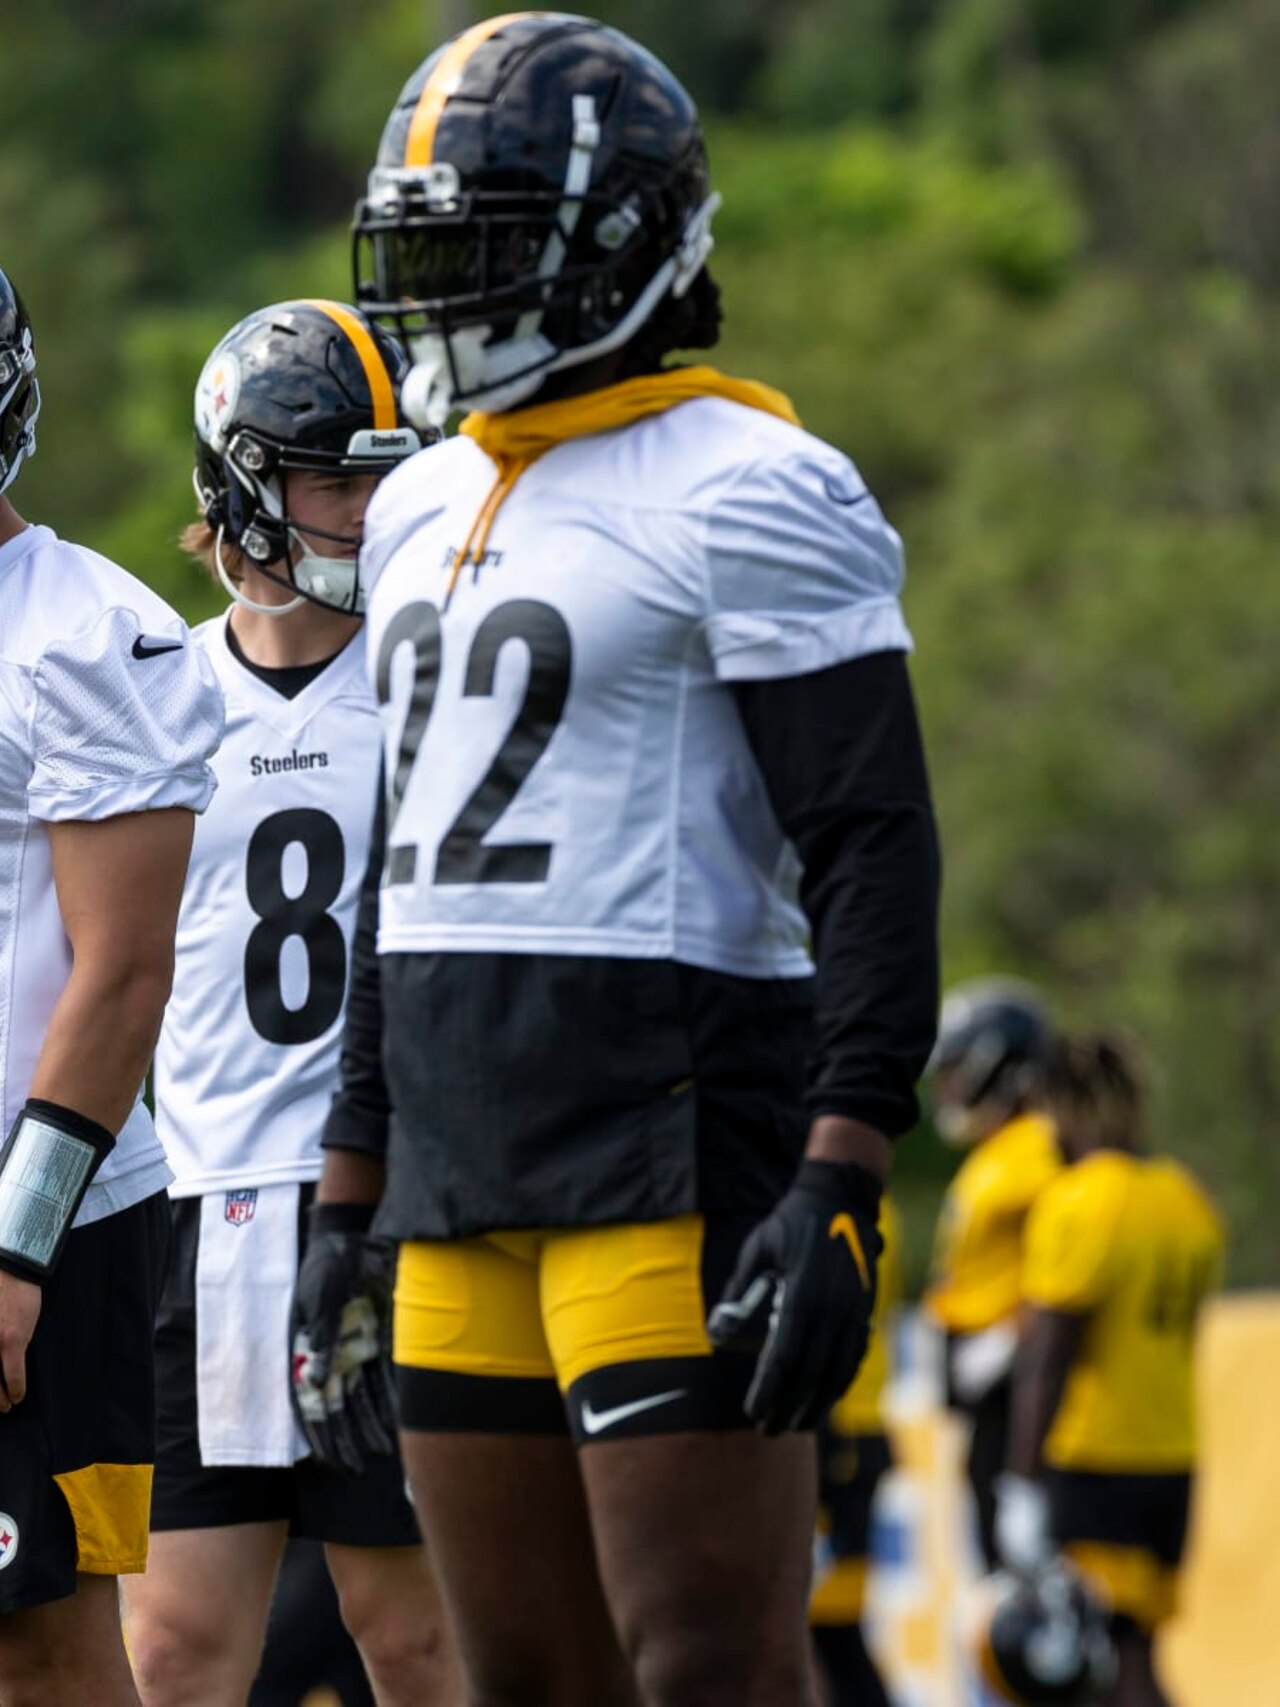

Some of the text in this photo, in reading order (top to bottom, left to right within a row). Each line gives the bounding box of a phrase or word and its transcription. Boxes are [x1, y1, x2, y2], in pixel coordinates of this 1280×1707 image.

[250, 748, 328, 776] Steelers
[376, 598, 574, 888] 22
[244, 808, 347, 1045] 8
